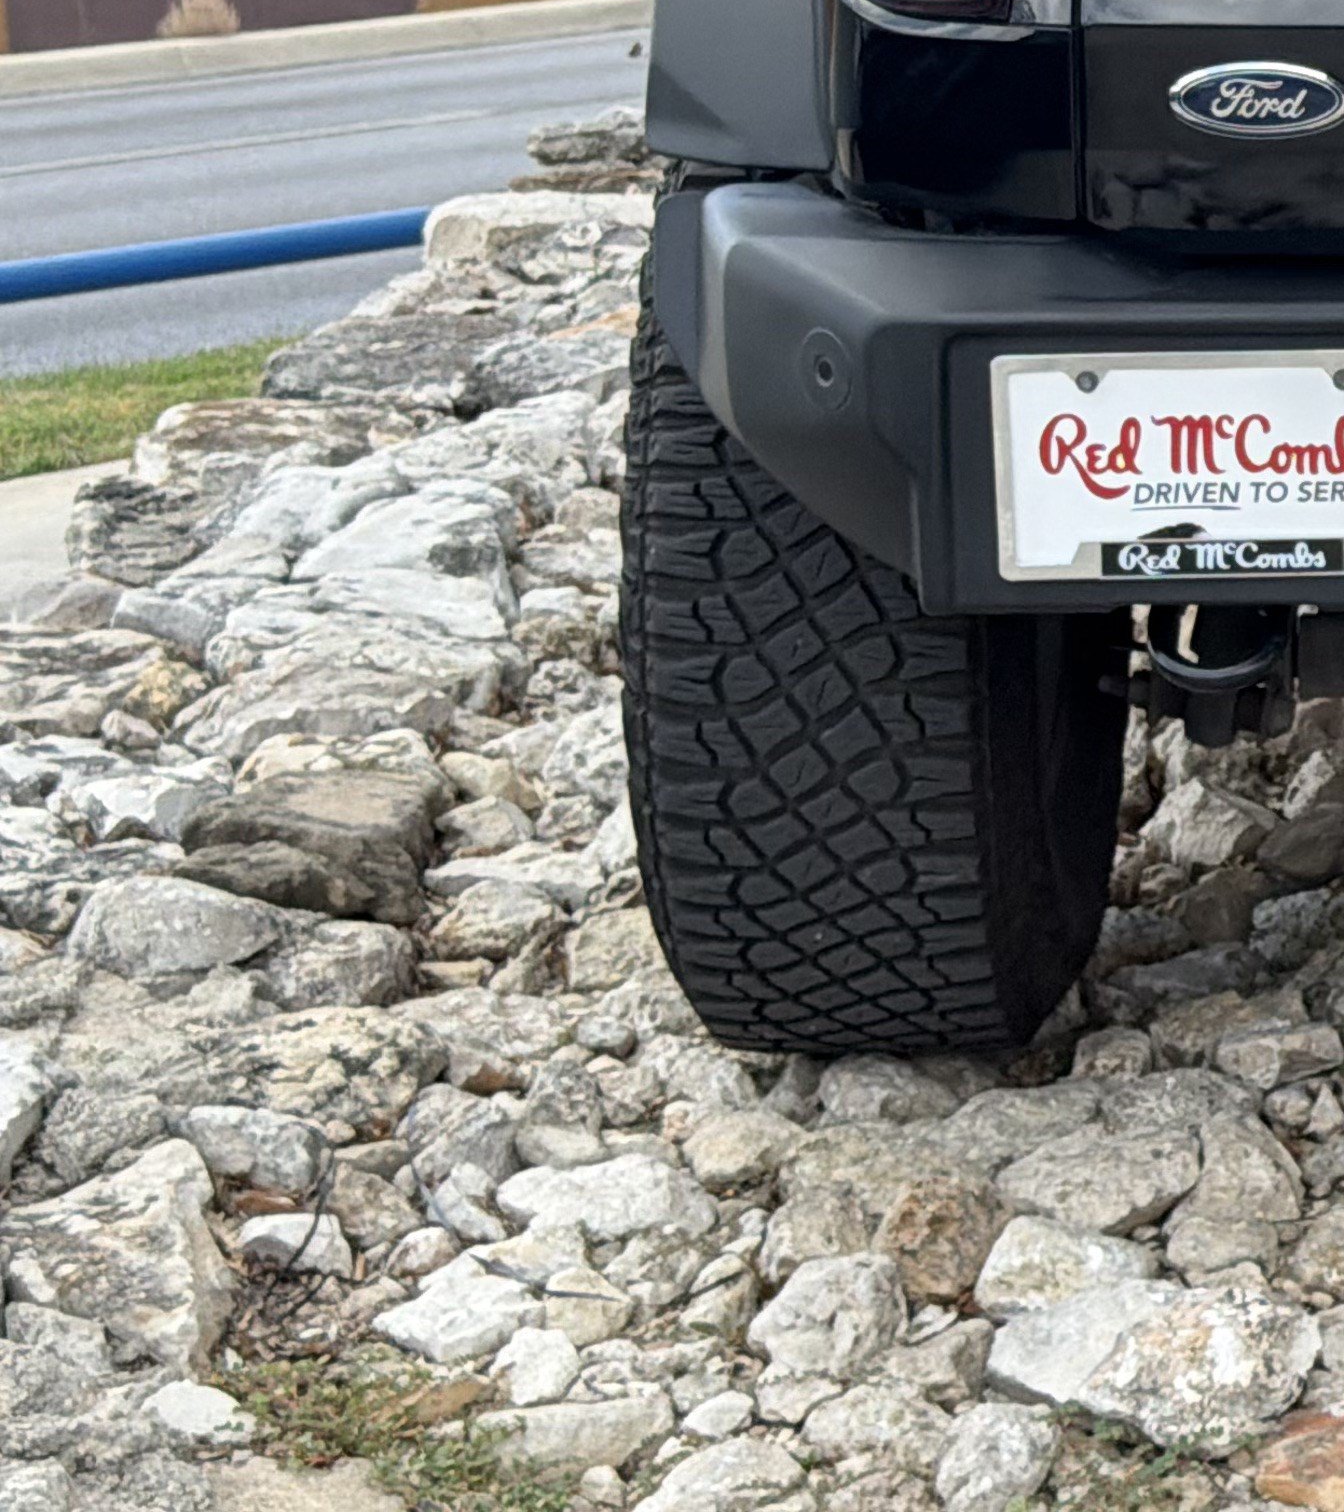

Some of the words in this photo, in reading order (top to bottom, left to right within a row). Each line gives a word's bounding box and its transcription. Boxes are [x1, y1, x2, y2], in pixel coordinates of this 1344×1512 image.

[1210, 78, 1308, 119] Ford
[1039, 412, 1143, 500] Red
[1133, 481, 1241, 506] DRIVEN
[1250, 481, 1288, 504] TO
[1117, 543, 1181, 575] Red
[1186, 538, 1327, 570] McCombs
